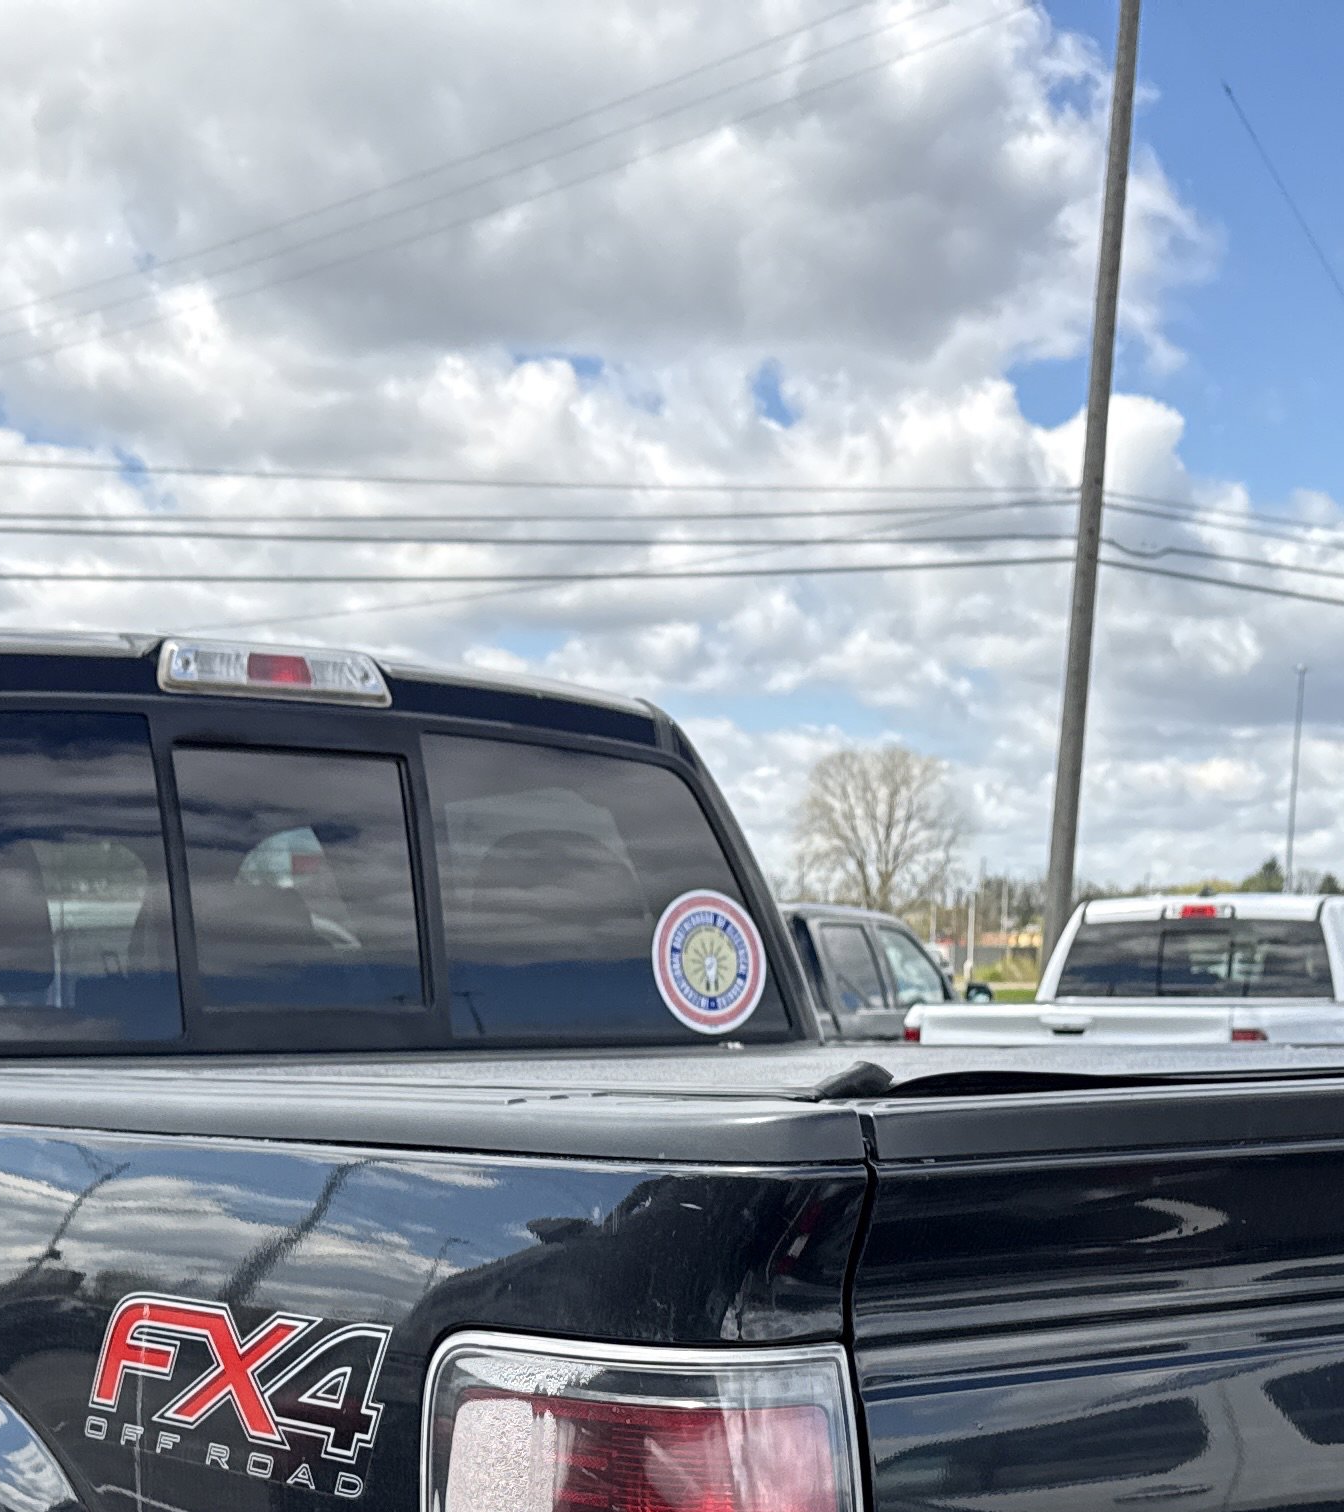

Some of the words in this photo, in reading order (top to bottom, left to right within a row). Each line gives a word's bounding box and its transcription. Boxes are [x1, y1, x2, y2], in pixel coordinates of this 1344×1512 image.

[88, 1291, 394, 1464] FX4
[84, 1415, 181, 1454] OFF
[205, 1442, 364, 1499] ROAD
